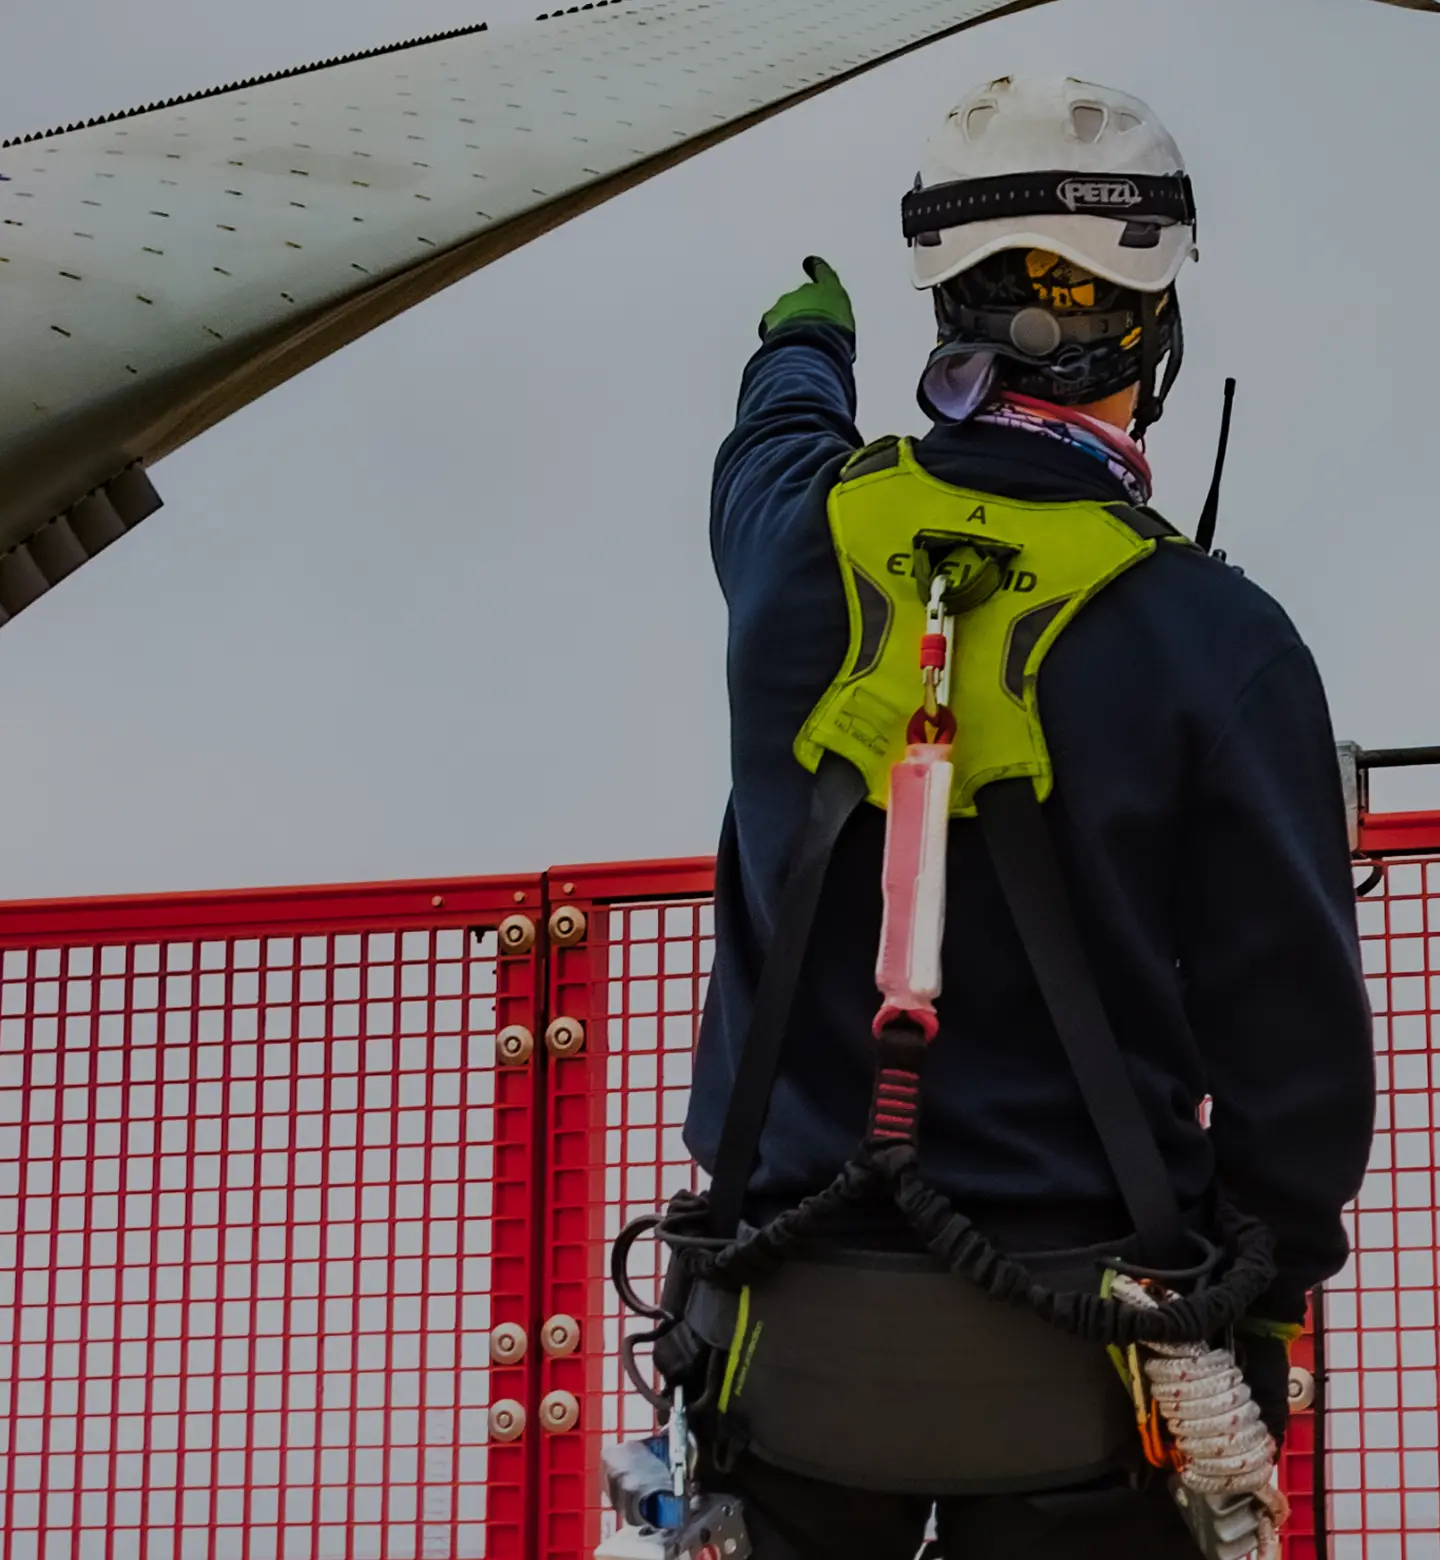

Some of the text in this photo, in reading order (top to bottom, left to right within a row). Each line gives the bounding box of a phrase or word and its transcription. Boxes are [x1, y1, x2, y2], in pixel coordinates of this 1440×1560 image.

[1064, 182, 1142, 212] PETZL
[966, 504, 987, 525] A
[886, 552, 1038, 593] EELID
